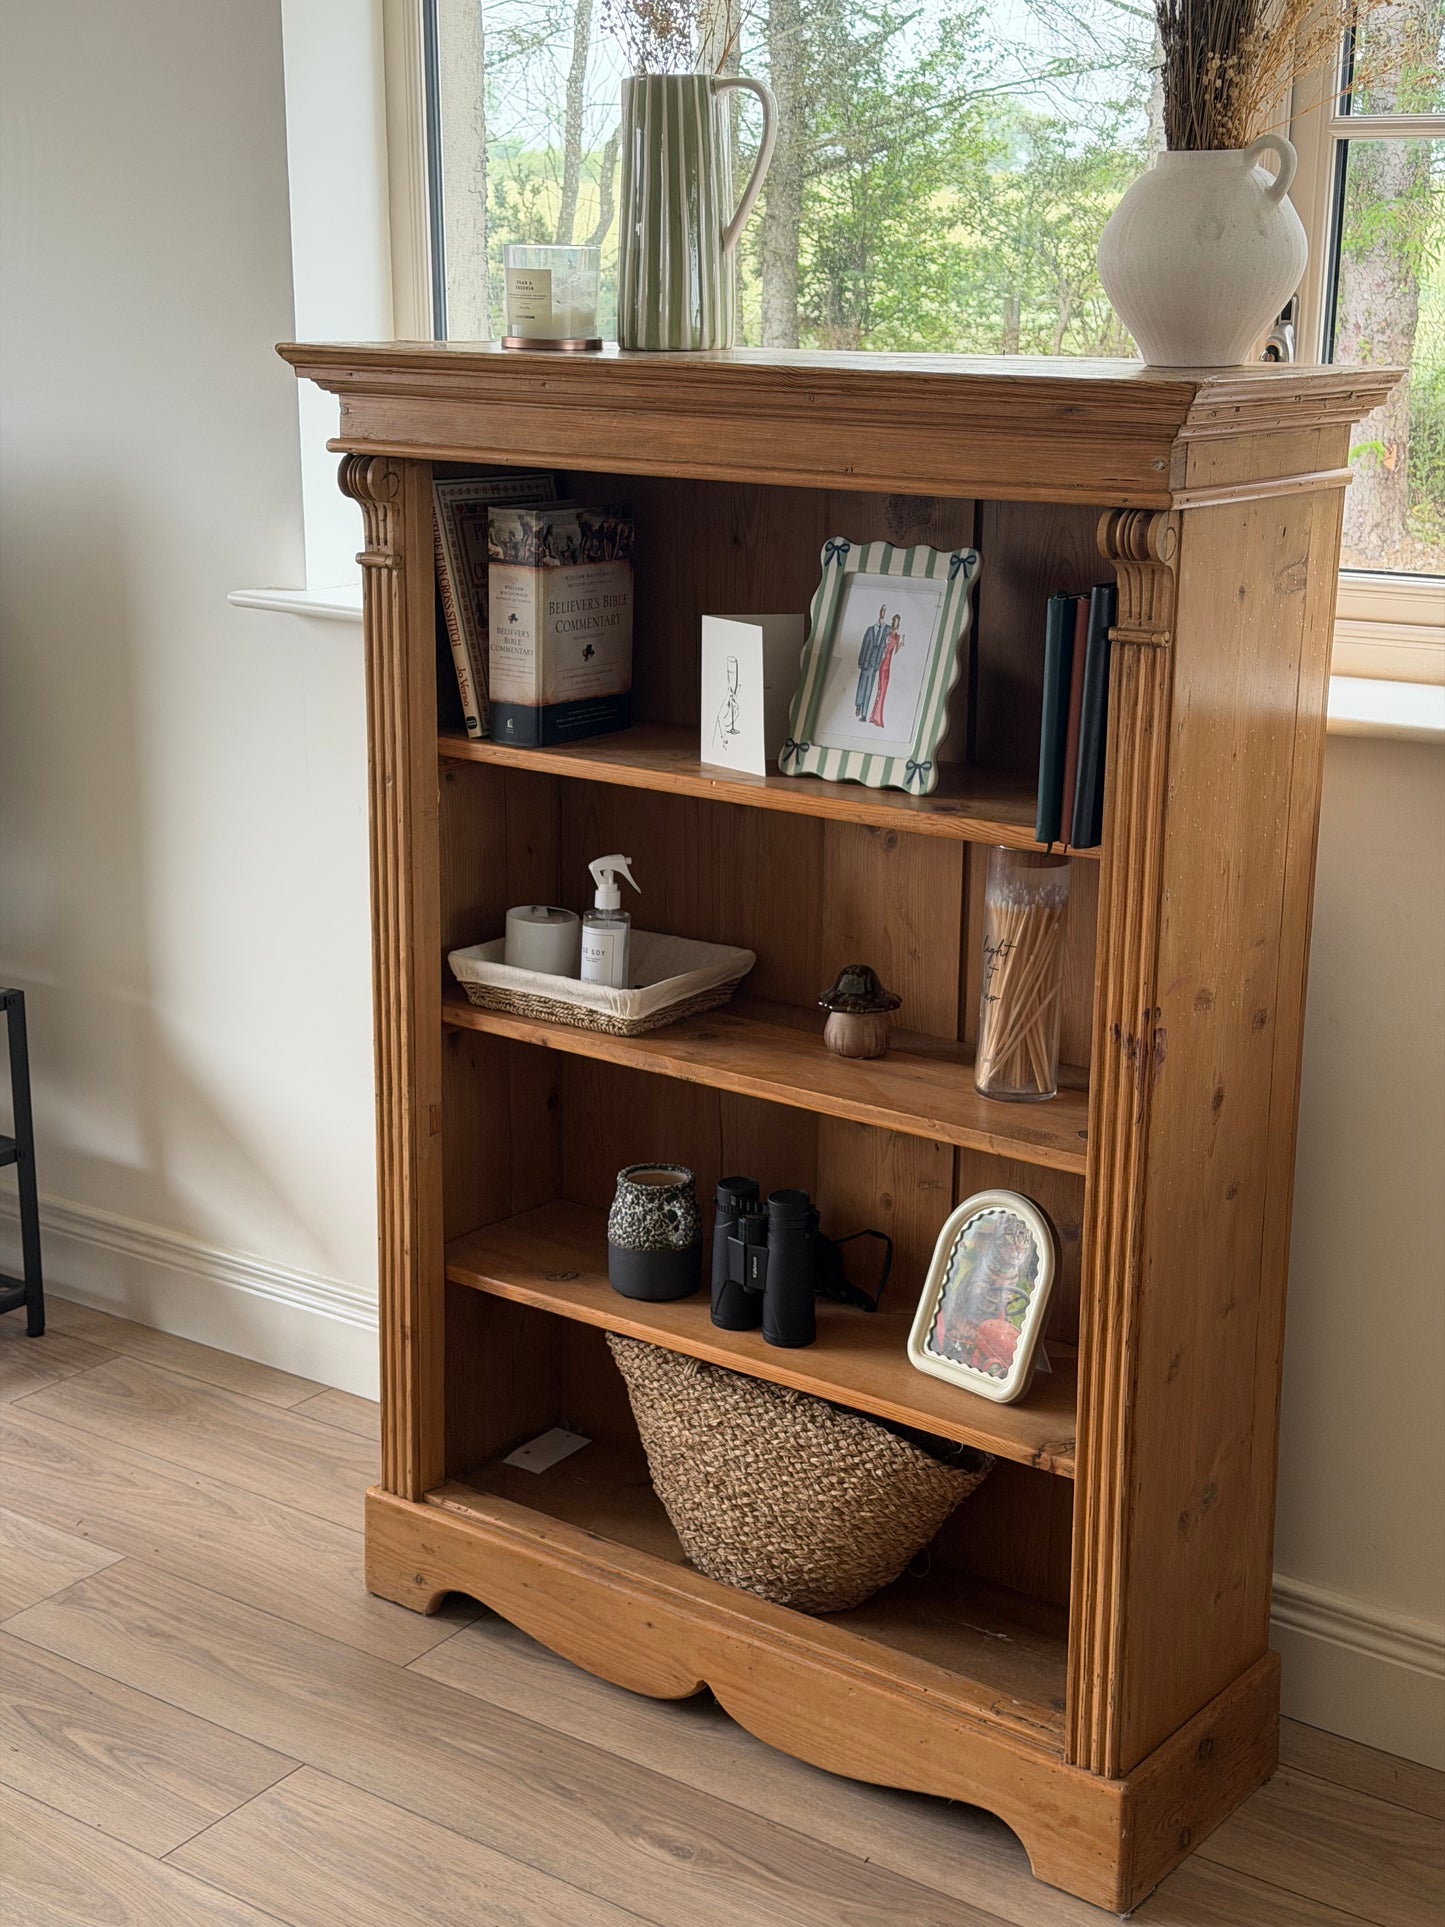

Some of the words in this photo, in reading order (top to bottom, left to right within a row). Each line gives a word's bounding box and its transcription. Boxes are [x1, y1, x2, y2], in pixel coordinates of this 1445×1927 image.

[437, 565, 448, 577] IN
[440, 578, 455, 610] CROSS
[603, 593, 629, 608] BIBLE
[445, 610, 462, 648] STITCH
[555, 612, 622, 634] COMMENTARY
[490, 644, 534, 657] COMMENTARY
[503, 636, 522, 647] BIBLE
[456, 665, 467, 679] Jo
[459, 678, 470, 708] Verso
[983, 934, 1018, 966] light
[986, 964, 999, 987] it
